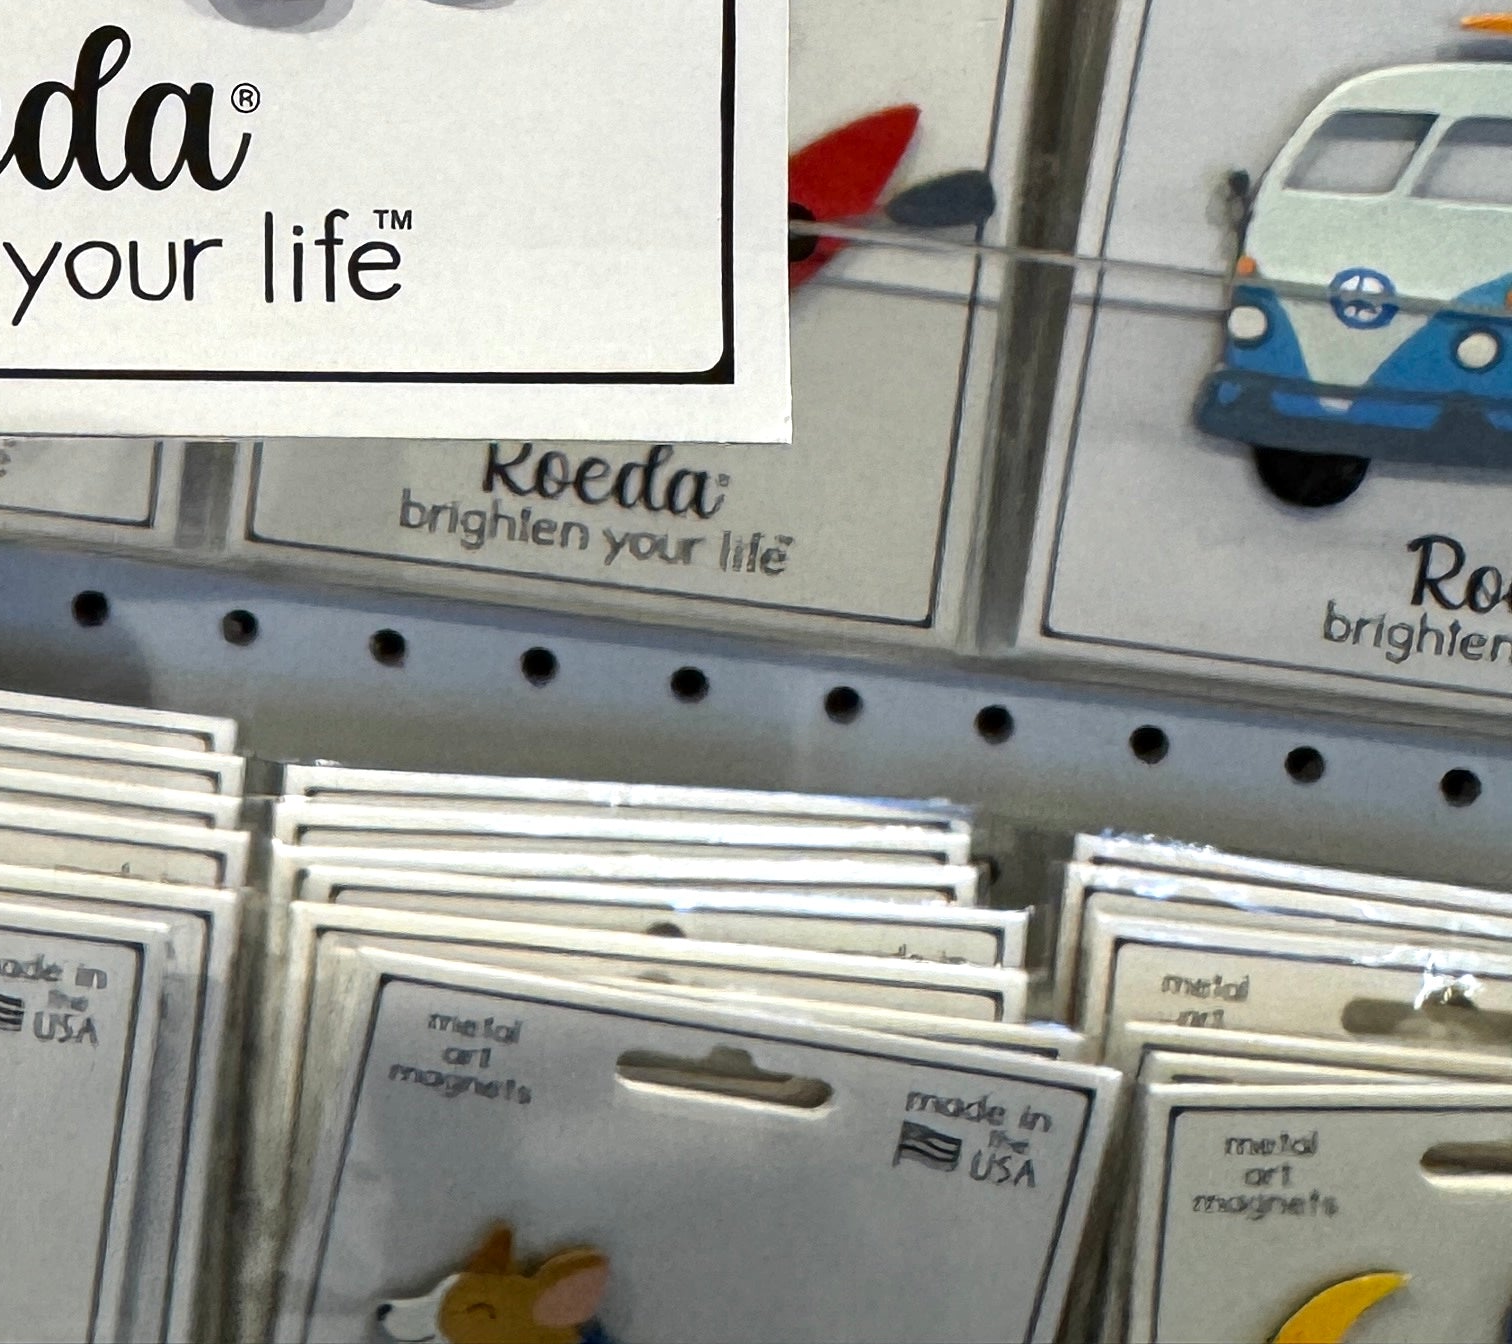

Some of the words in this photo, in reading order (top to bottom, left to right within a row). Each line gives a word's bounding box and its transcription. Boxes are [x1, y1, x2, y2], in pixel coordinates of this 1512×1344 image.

[2, 238, 224, 327] your
[398, 487, 590, 552] brighten
[602, 528, 706, 566] your
[33, 1009, 99, 1047] USA
[969, 1148, 1037, 1189] USA
